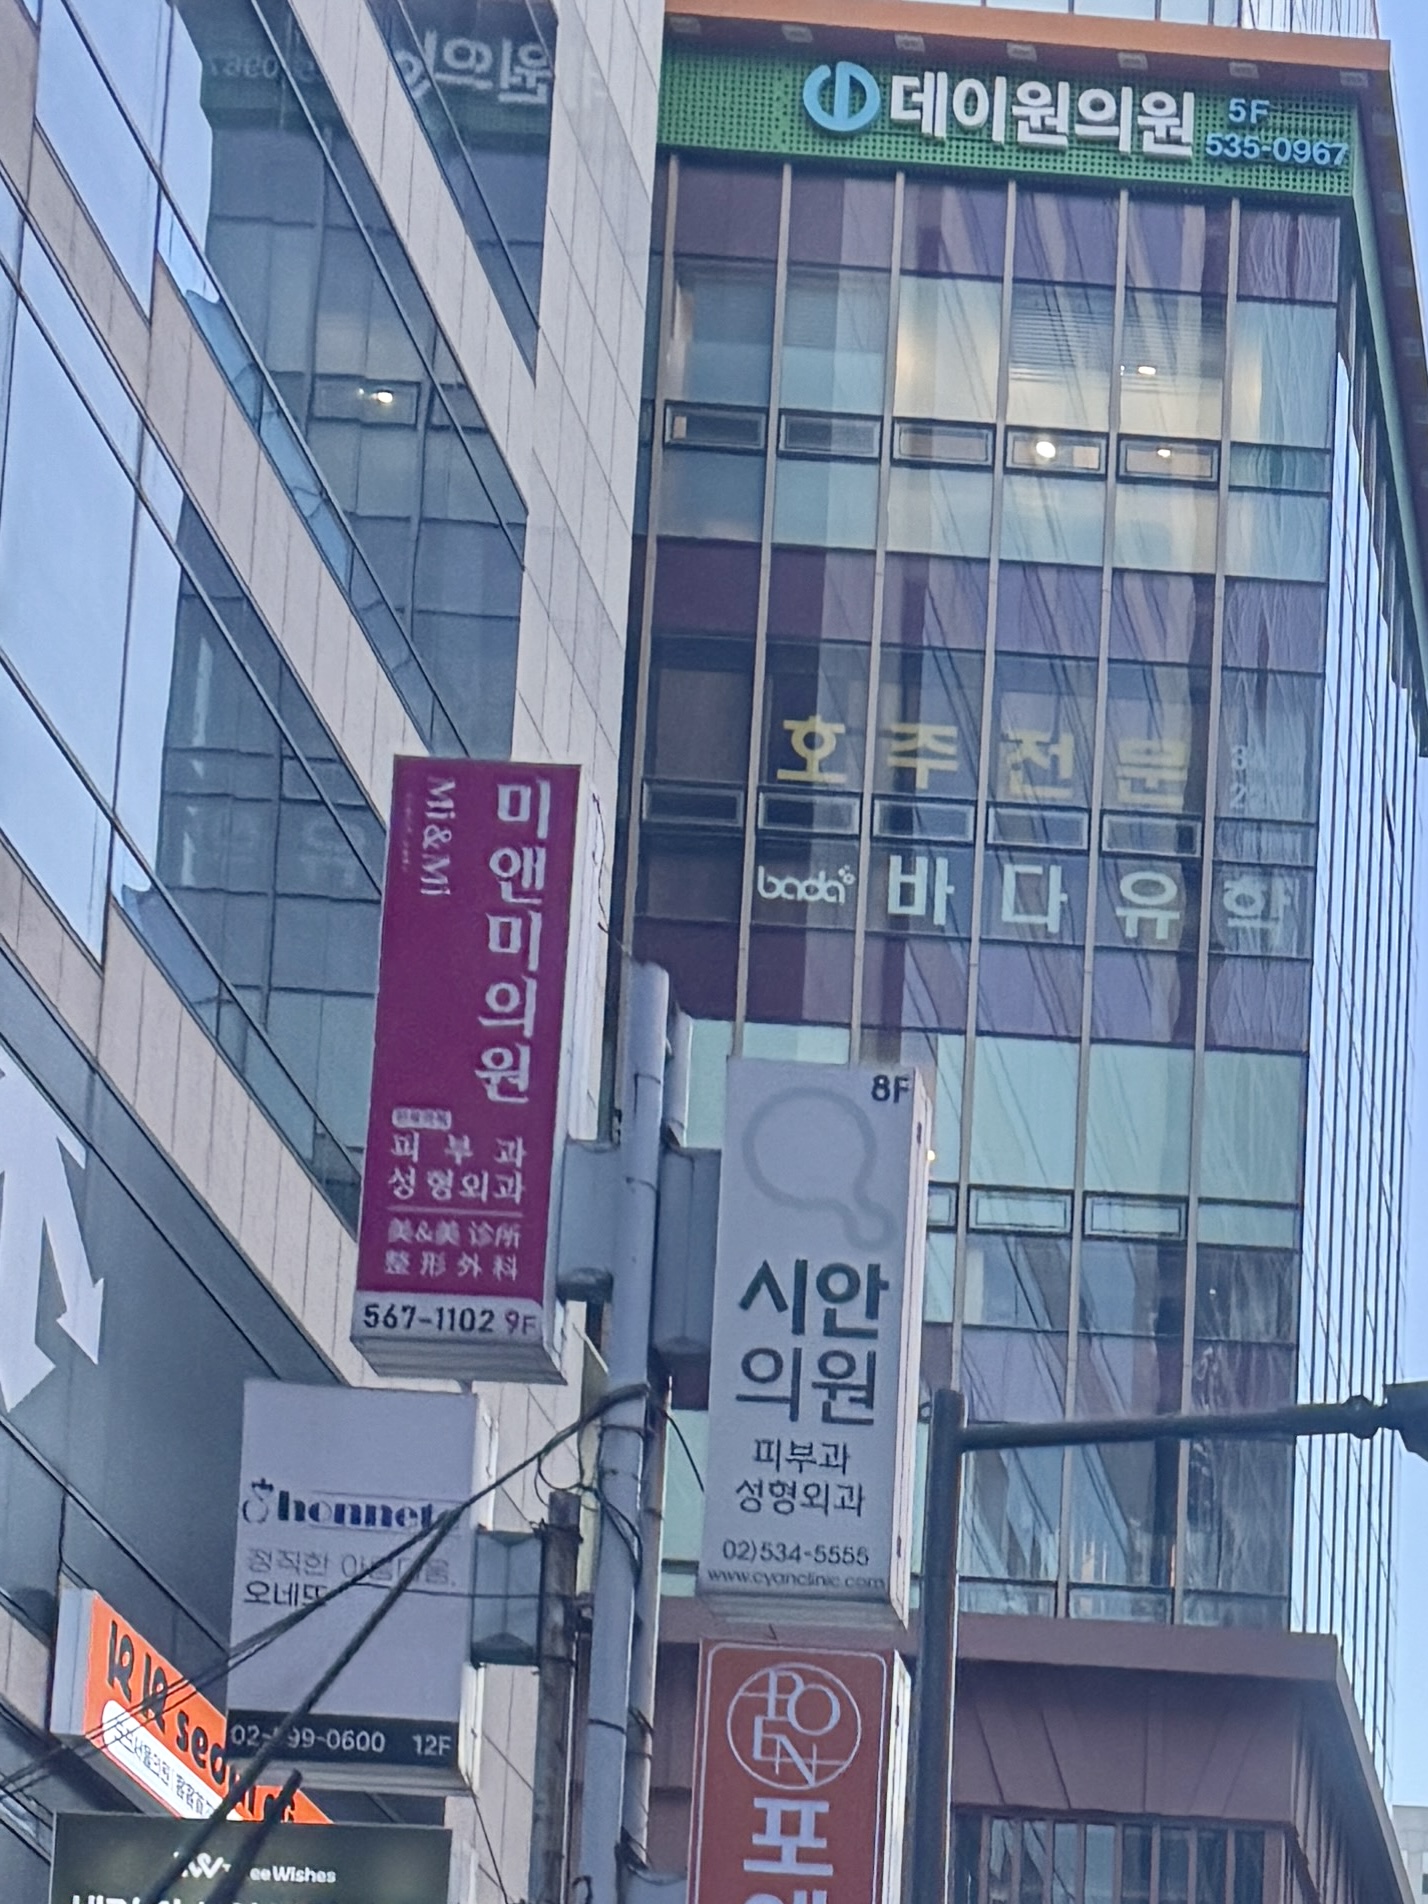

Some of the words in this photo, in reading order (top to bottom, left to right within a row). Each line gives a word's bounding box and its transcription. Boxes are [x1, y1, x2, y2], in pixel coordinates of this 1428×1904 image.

[890, 72, 1194, 159] 데이원의원
[1228, 97, 1271, 126] 5F
[1205, 130, 1351, 167] 535-0967
[419, 775, 456, 896] Mi&Mi
[474, 776, 550, 1104] 미앤미의원
[870, 1074, 911, 1104] 8F
[389, 1165, 526, 1205] 성형외과
[363, 1303, 494, 1333] 567-1102
[505, 1311, 537, 1334] 9F
[739, 1259, 890, 1341] 시안
[735, 1347, 876, 1427] 의원
[753, 1438, 851, 1475] 피부과
[735, 1479, 866, 1518] 성형외과
[230, 1723, 386, 1754] 02-99-0600
[412, 1733, 451, 1757] 12F
